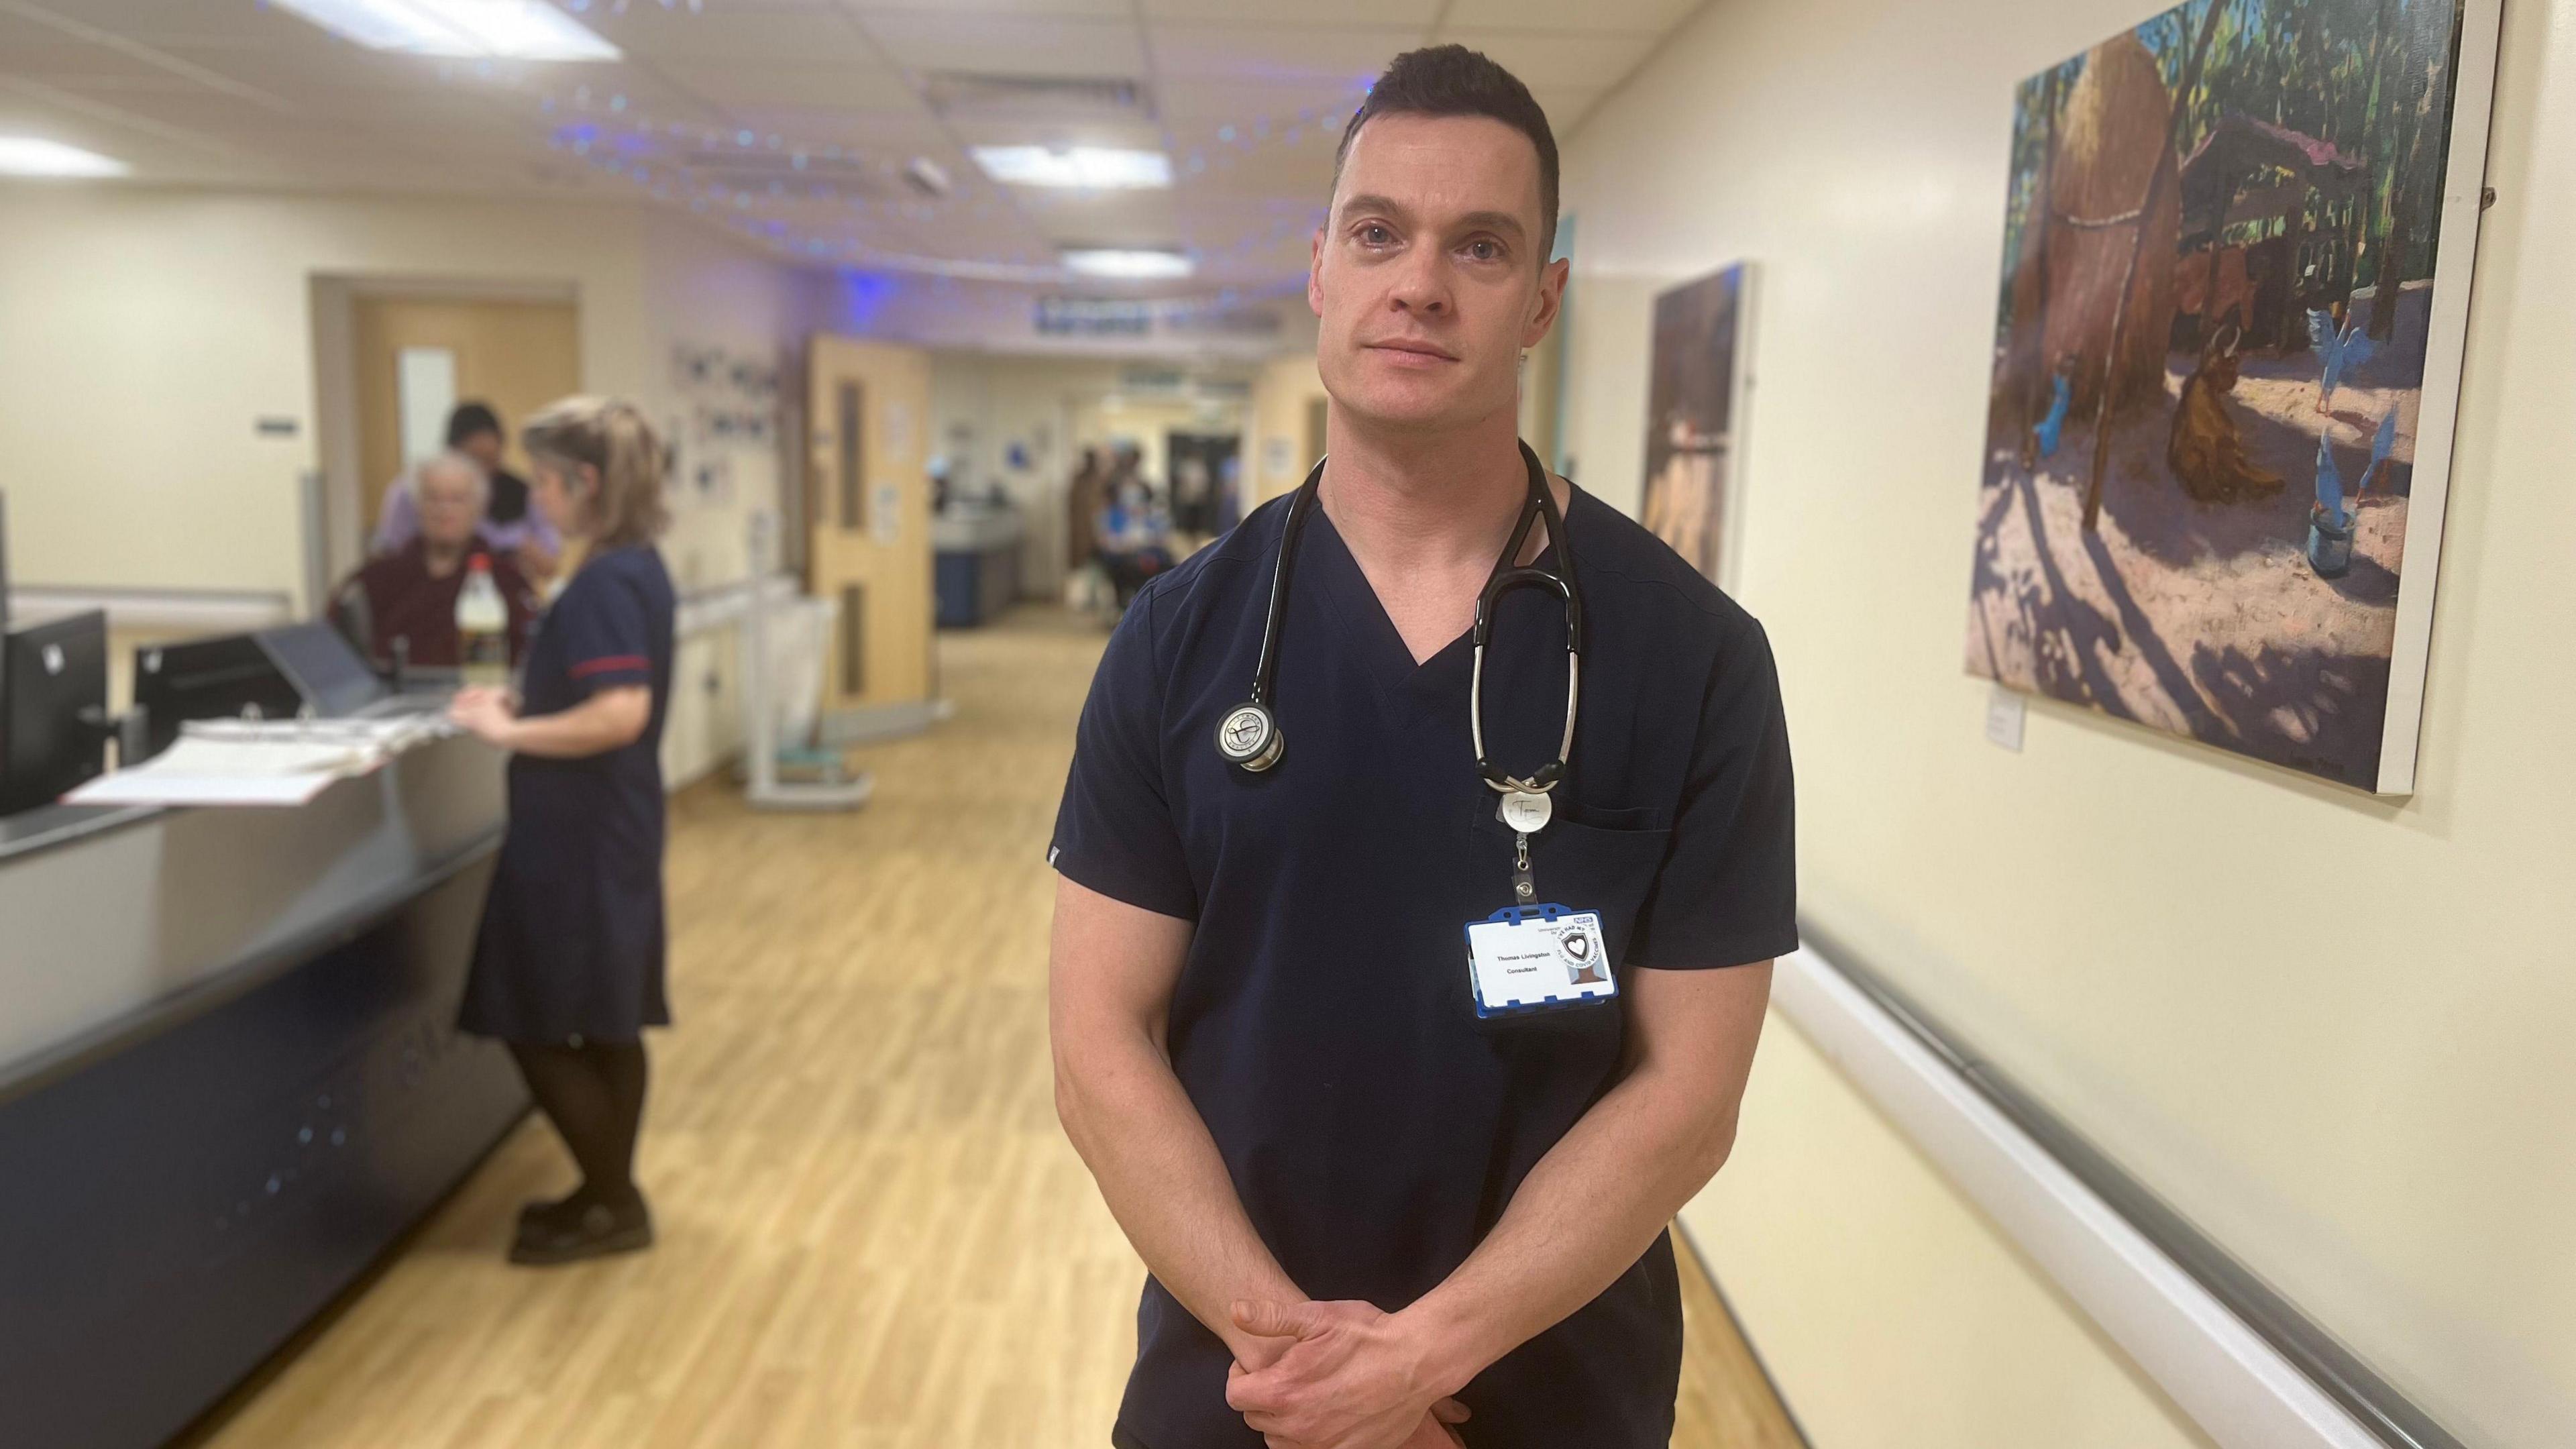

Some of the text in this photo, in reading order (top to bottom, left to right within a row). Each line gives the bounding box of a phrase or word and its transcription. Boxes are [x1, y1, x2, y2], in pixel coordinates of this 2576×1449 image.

[1512, 800, 1540, 816] Tom
[1564, 958, 1574, 966] AND
[1507, 966, 1538, 974] Consultant
